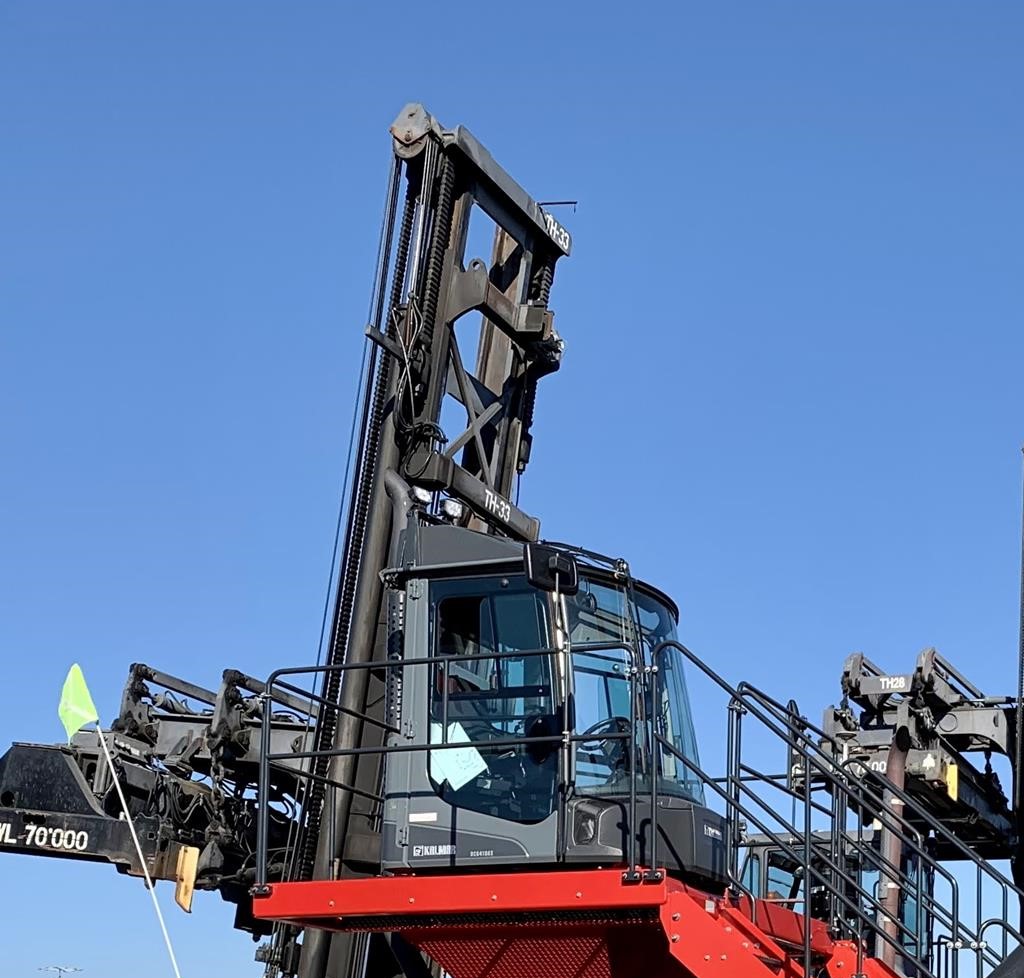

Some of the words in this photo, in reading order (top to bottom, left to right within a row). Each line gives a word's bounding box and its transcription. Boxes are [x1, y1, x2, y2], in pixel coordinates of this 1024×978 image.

[545, 213, 570, 250] TH-33
[485, 489, 510, 523] TH-33
[880, 677, 906, 689] TH28
[25, 824, 88, 850] 70'000
[424, 845, 456, 856] KALMAR
